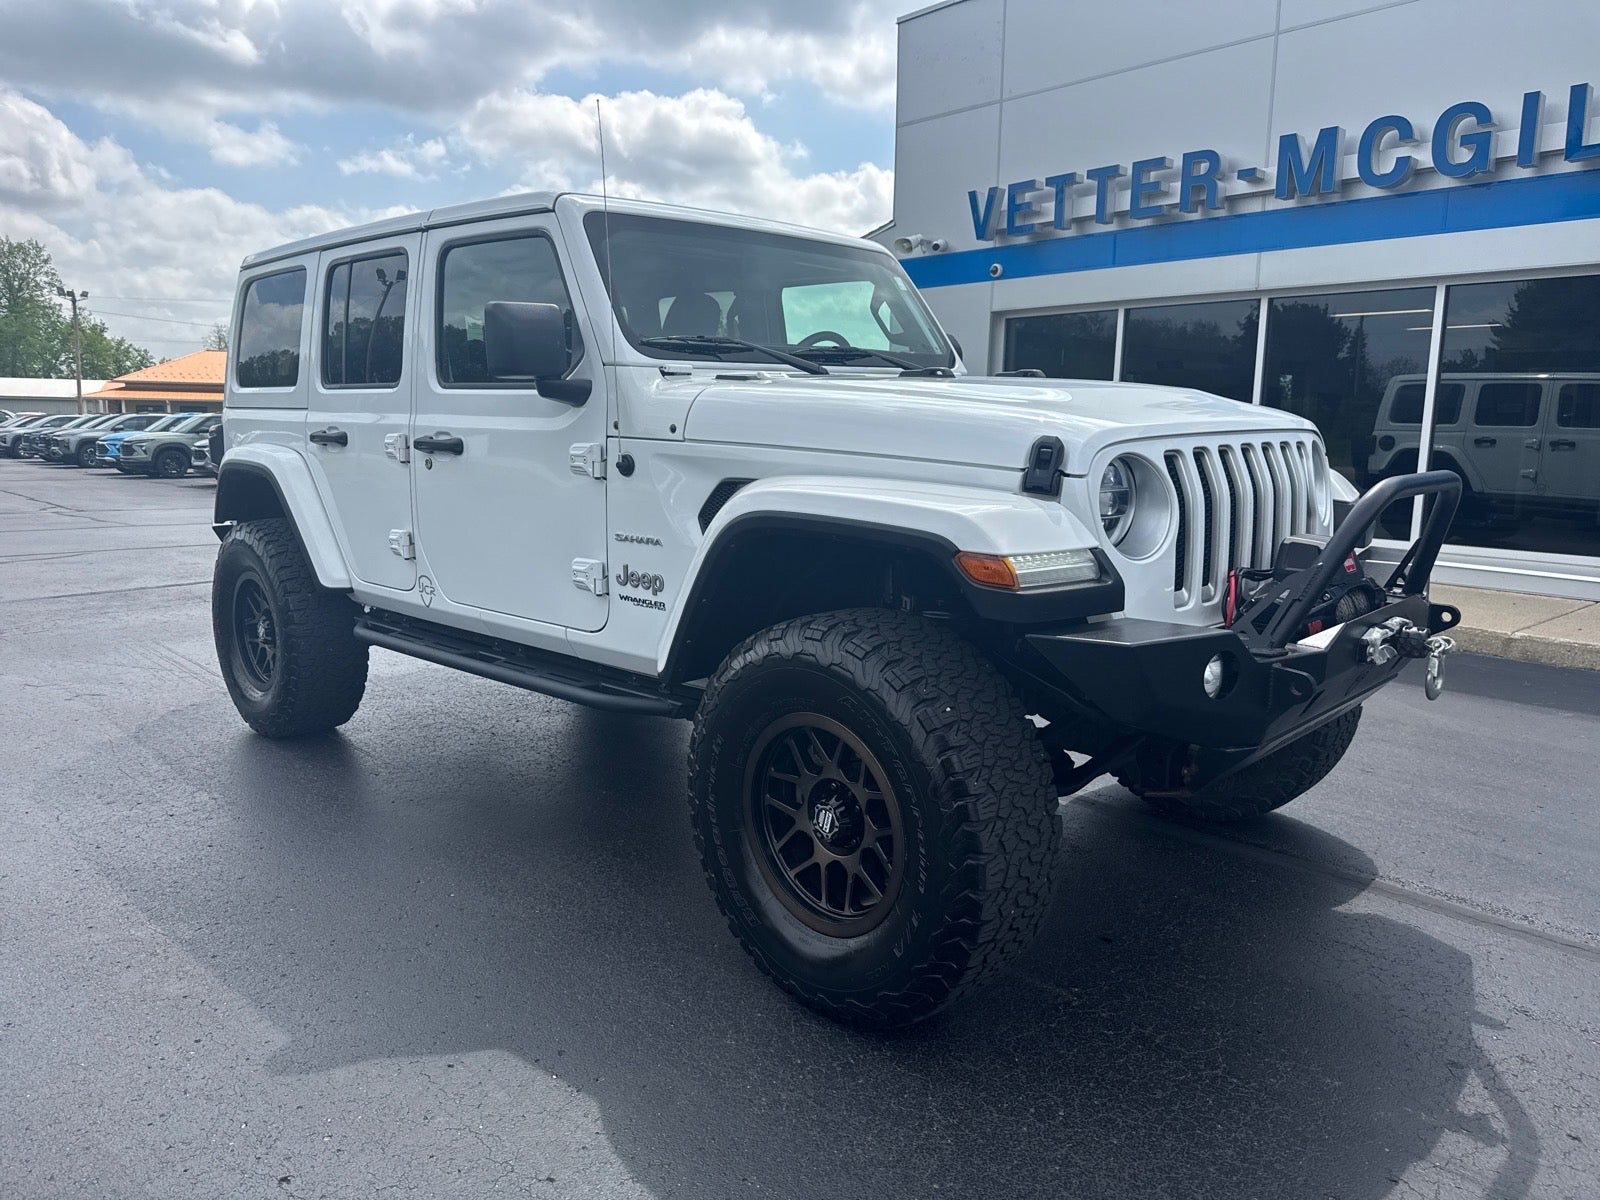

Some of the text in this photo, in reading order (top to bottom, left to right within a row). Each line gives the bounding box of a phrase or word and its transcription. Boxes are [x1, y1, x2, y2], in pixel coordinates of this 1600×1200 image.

[614, 533, 663, 547] SAHARA
[616, 564, 664, 596] Jeep
[619, 594, 666, 608] WRANGLER
